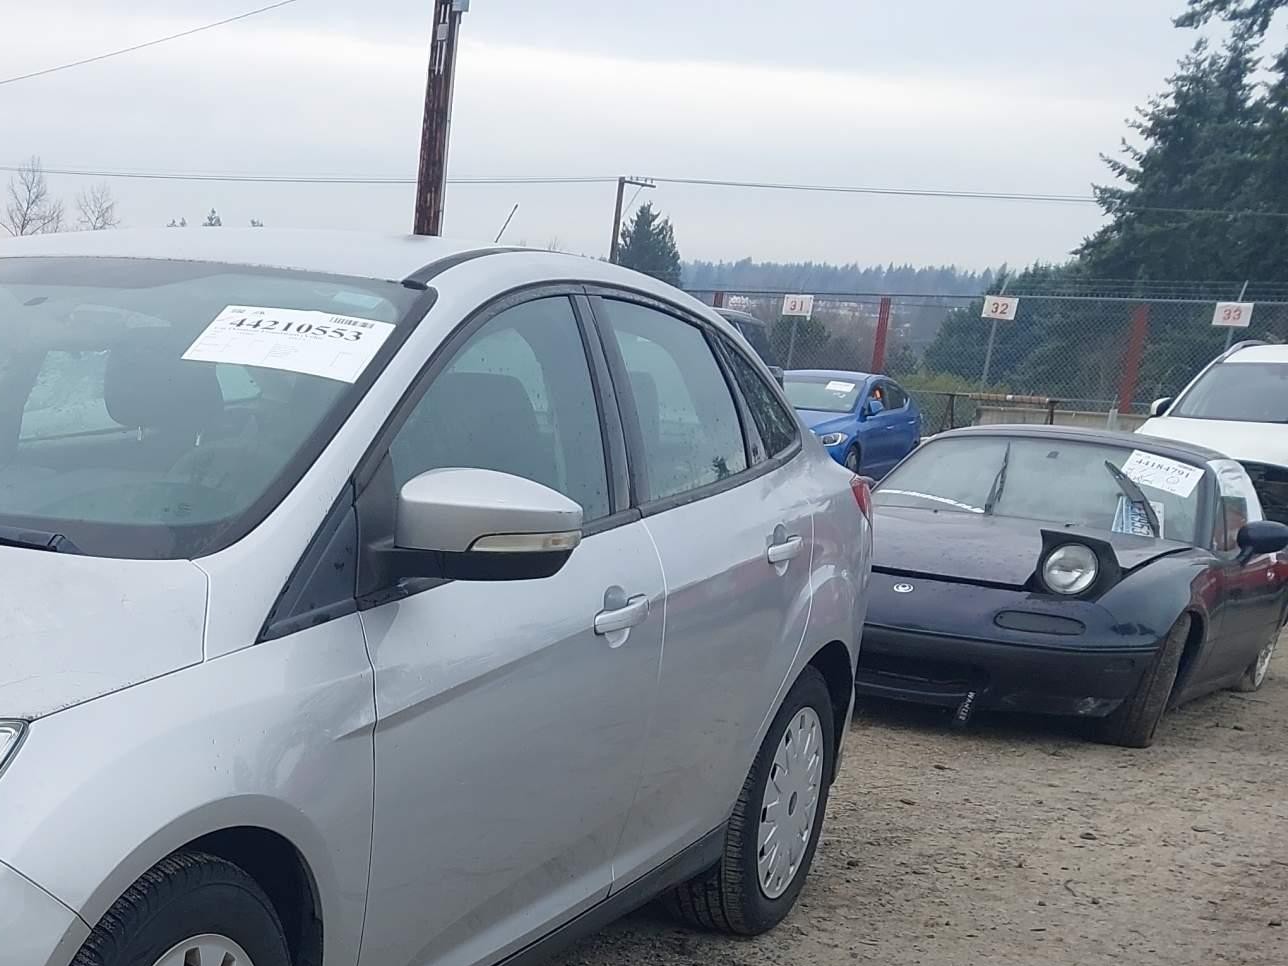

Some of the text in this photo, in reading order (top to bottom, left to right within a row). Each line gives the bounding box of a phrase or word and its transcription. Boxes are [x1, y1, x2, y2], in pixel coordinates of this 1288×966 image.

[789, 299, 804, 312] 31
[991, 302, 1009, 315] 32
[1222, 308, 1242, 321] 33
[228, 317, 365, 342] 44210553
